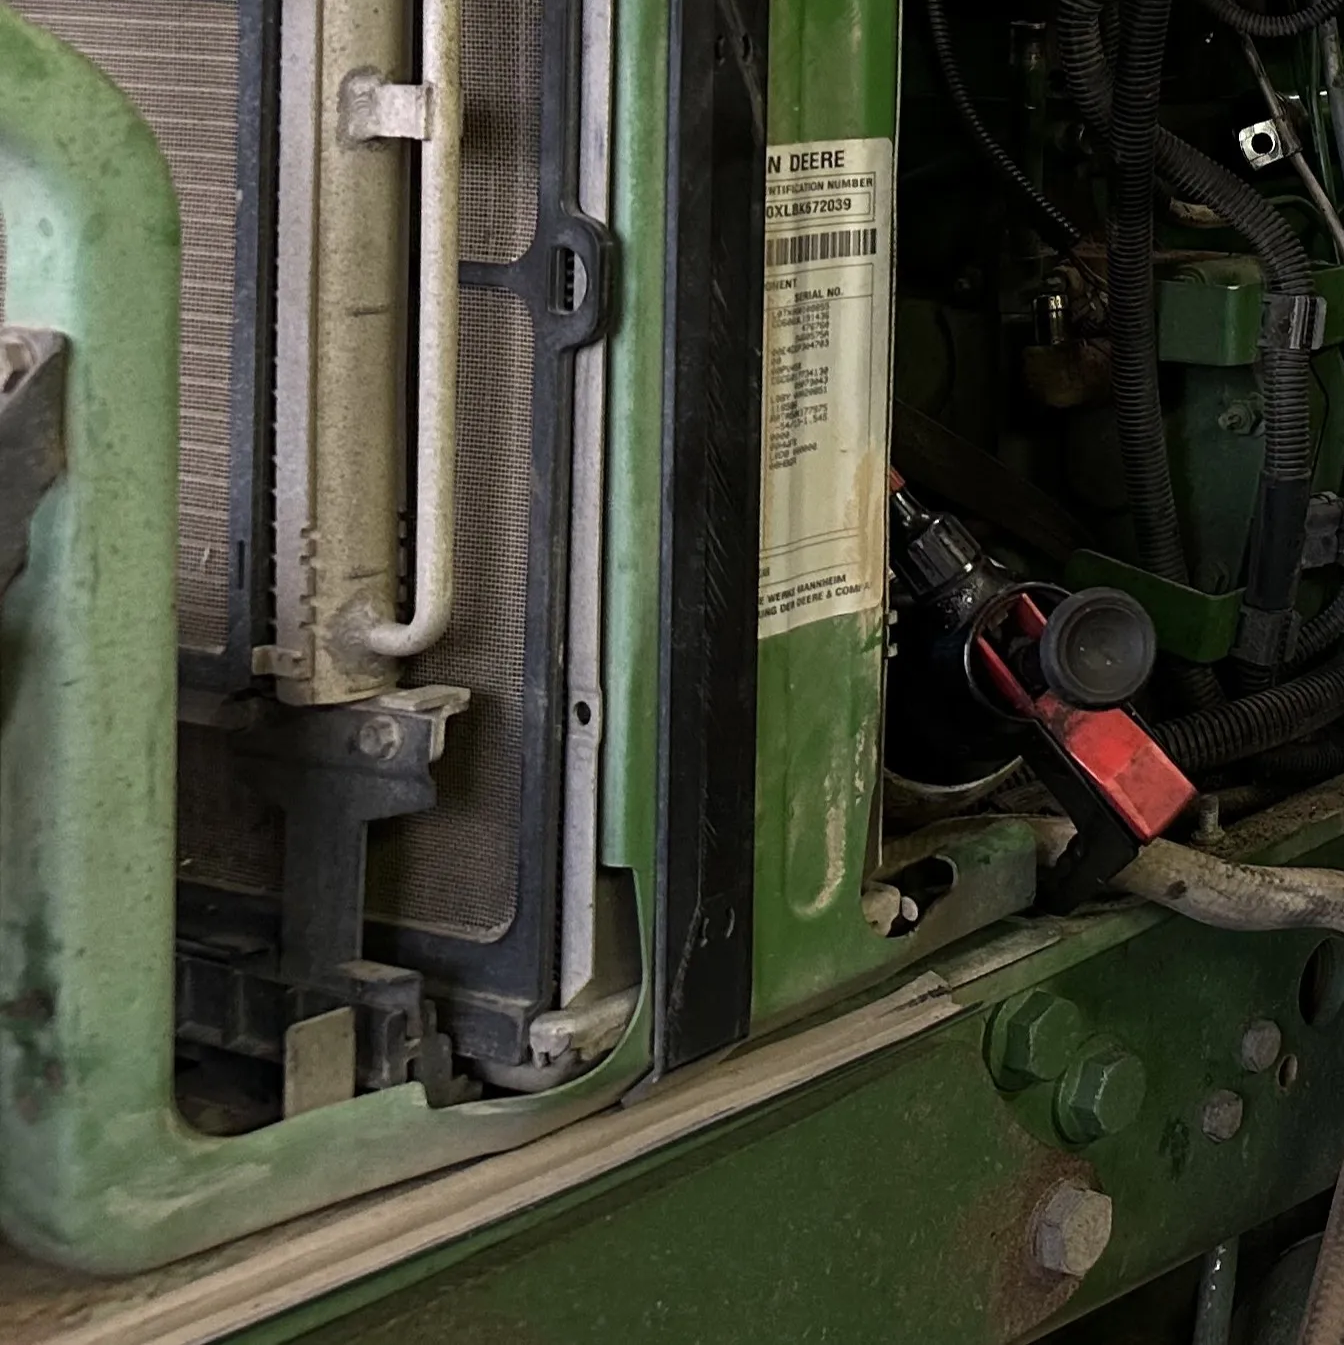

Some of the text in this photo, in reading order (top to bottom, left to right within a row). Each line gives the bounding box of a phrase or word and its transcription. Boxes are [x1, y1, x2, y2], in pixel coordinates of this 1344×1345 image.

[790, 150, 845, 172] DEERE
[827, 178, 873, 190] NUMBER
[827, 286, 844, 297] NO.
[797, 574, 847, 594] MANNHEIM
